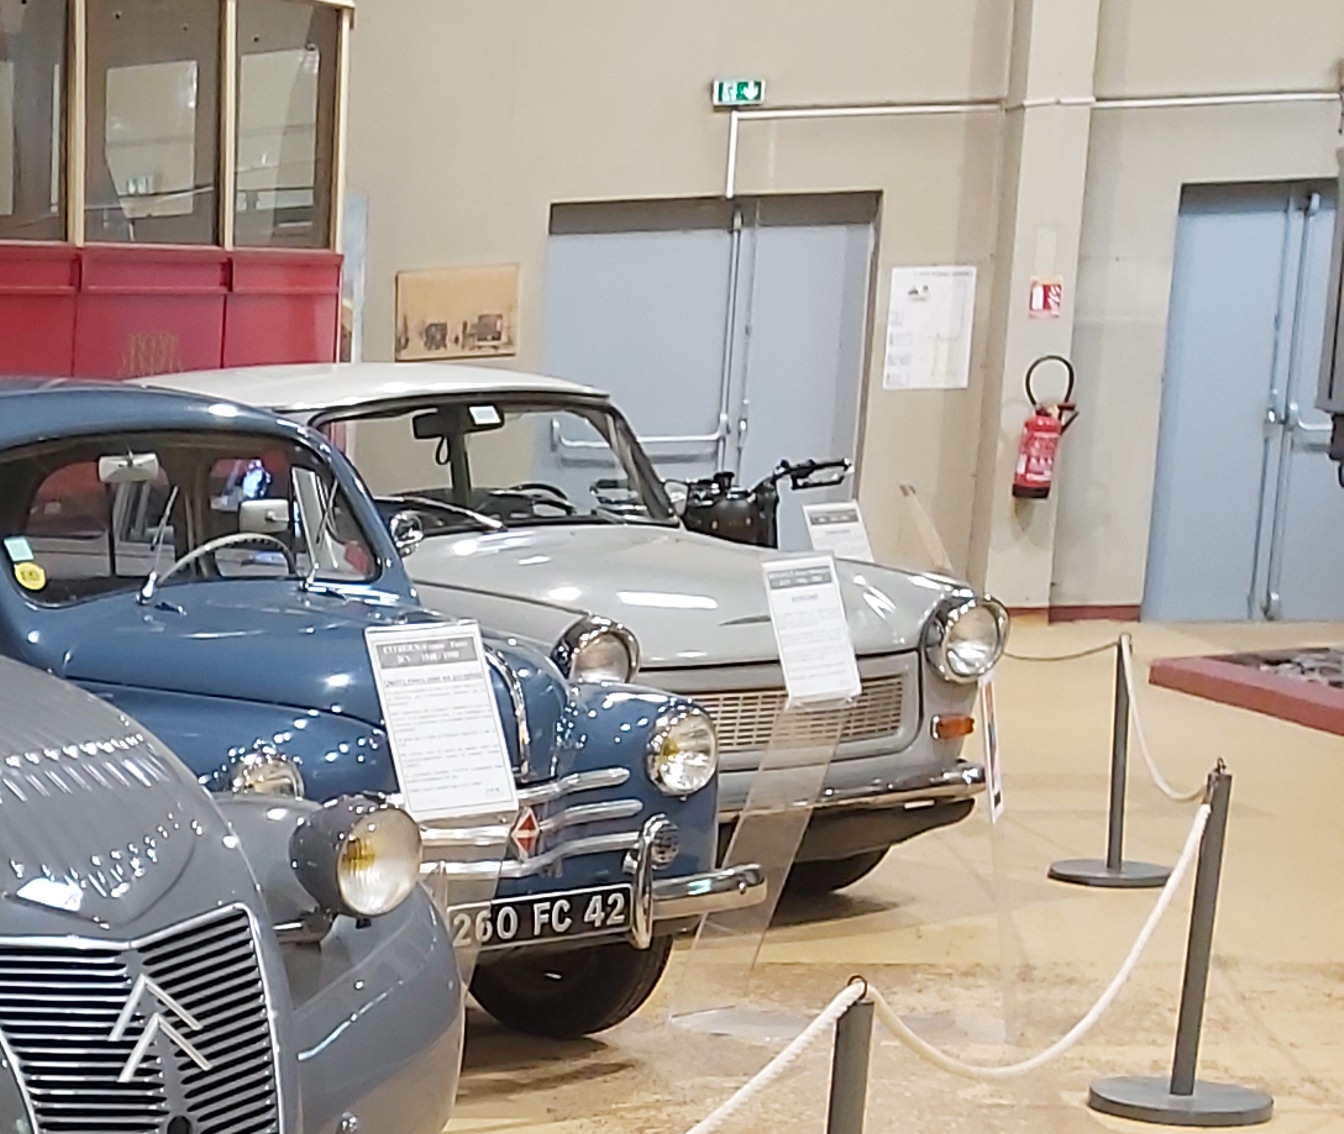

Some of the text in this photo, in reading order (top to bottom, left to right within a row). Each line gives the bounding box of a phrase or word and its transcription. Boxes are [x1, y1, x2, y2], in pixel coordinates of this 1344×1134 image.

[452, 892, 626, 948] 260 FC 42
